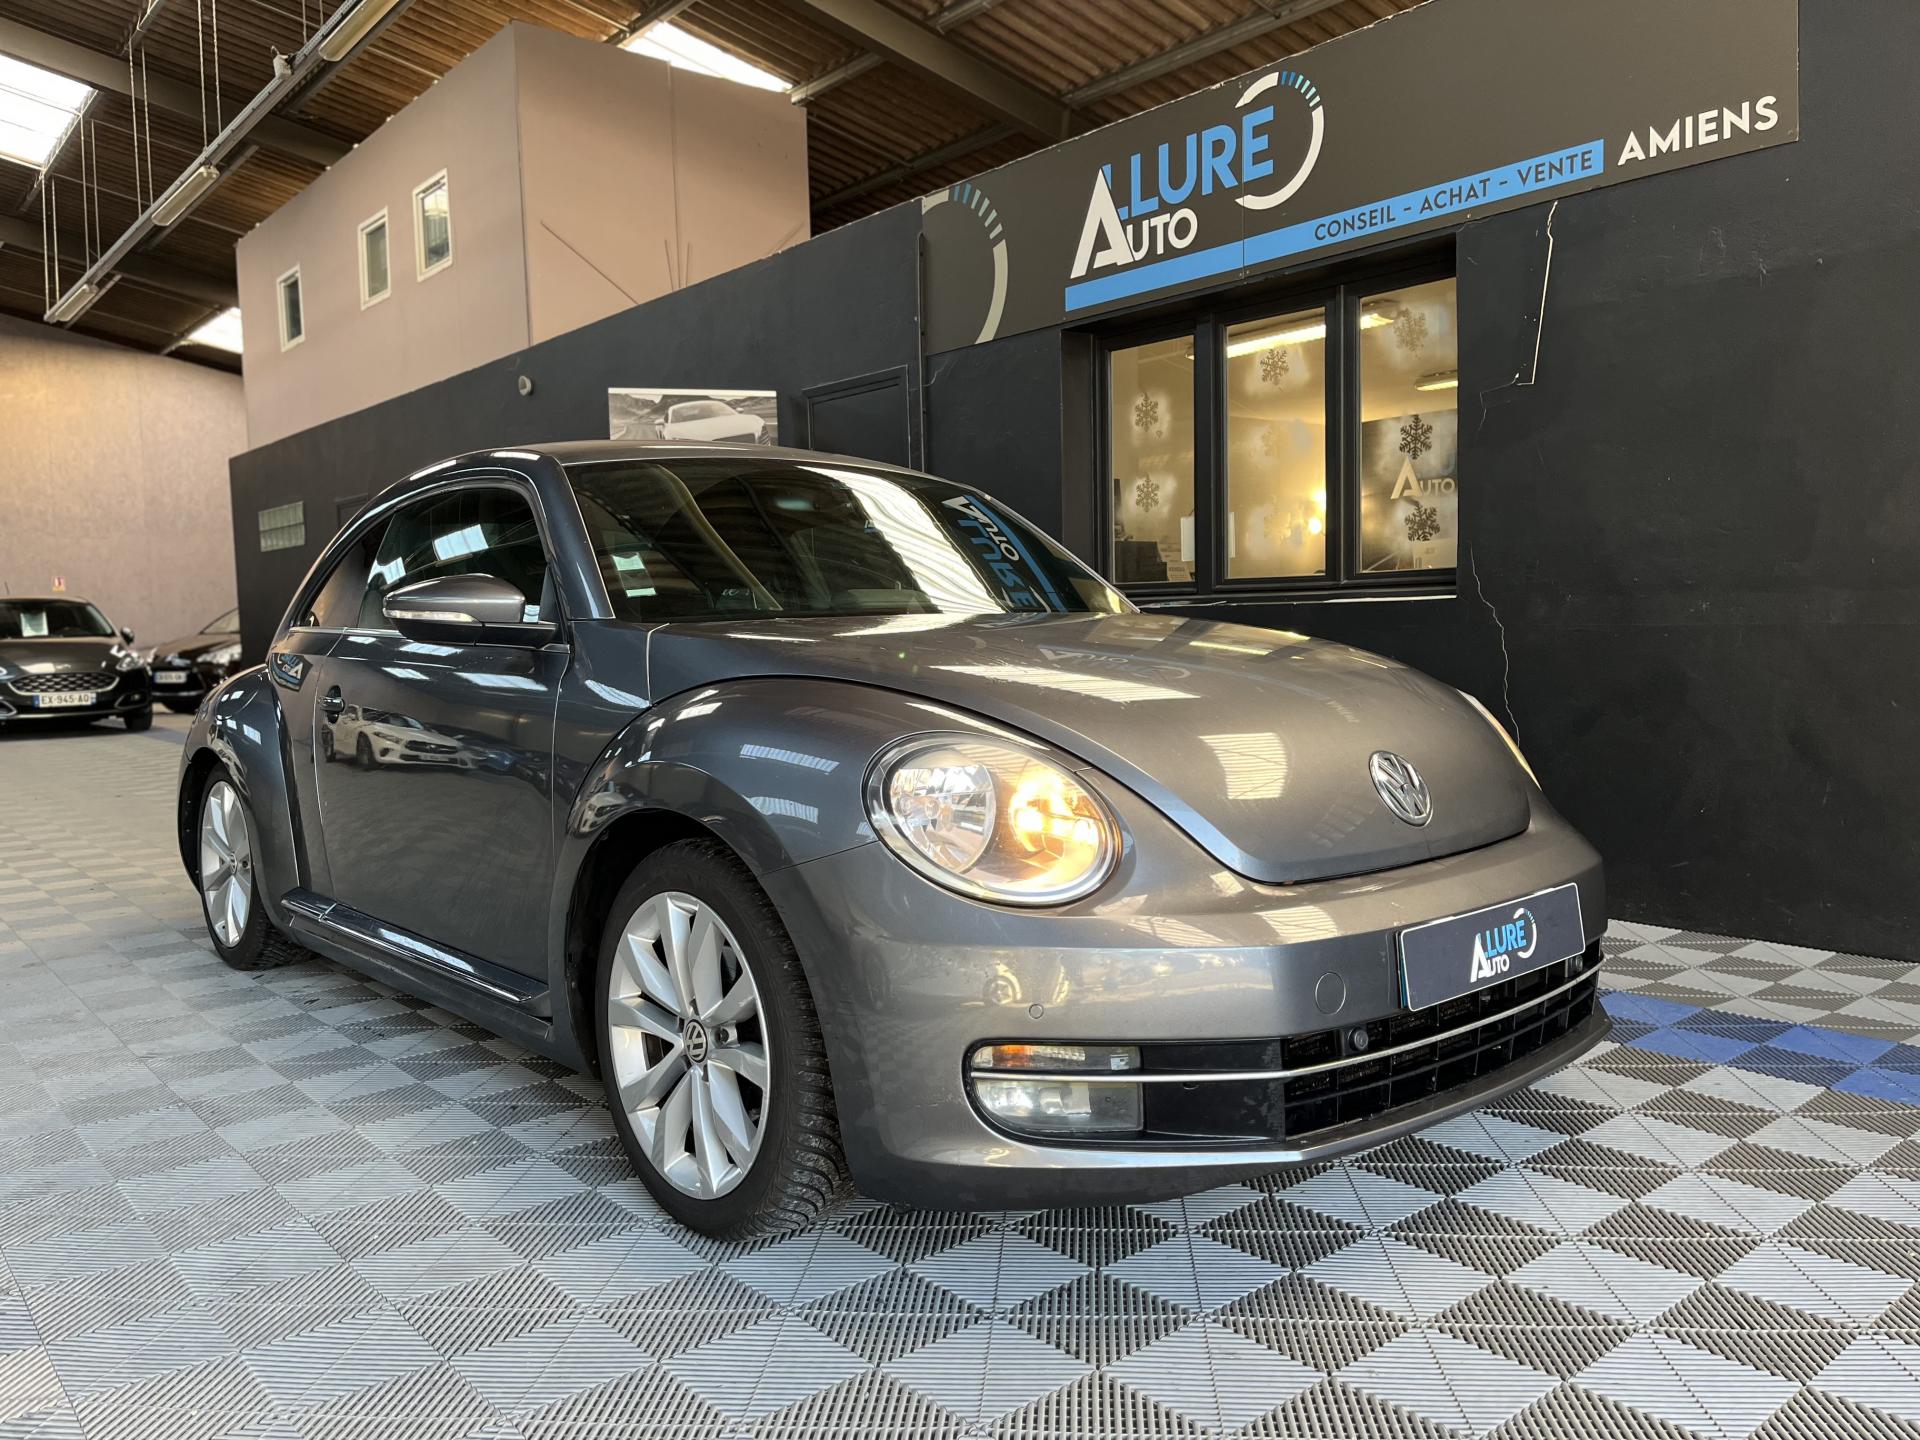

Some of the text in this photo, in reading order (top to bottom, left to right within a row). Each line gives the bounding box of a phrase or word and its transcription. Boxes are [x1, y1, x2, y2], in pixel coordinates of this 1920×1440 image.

[1617, 95, 1779, 166] AMIENS
[1070, 168, 1198, 279] AUTO
[1314, 205, 1396, 241] CONSEIL
[1419, 178, 1491, 214] ACHAT
[1517, 149, 1593, 188] VENTE
[1390, 456, 1456, 499] AUTO
[1470, 932, 1510, 983] AUTO
